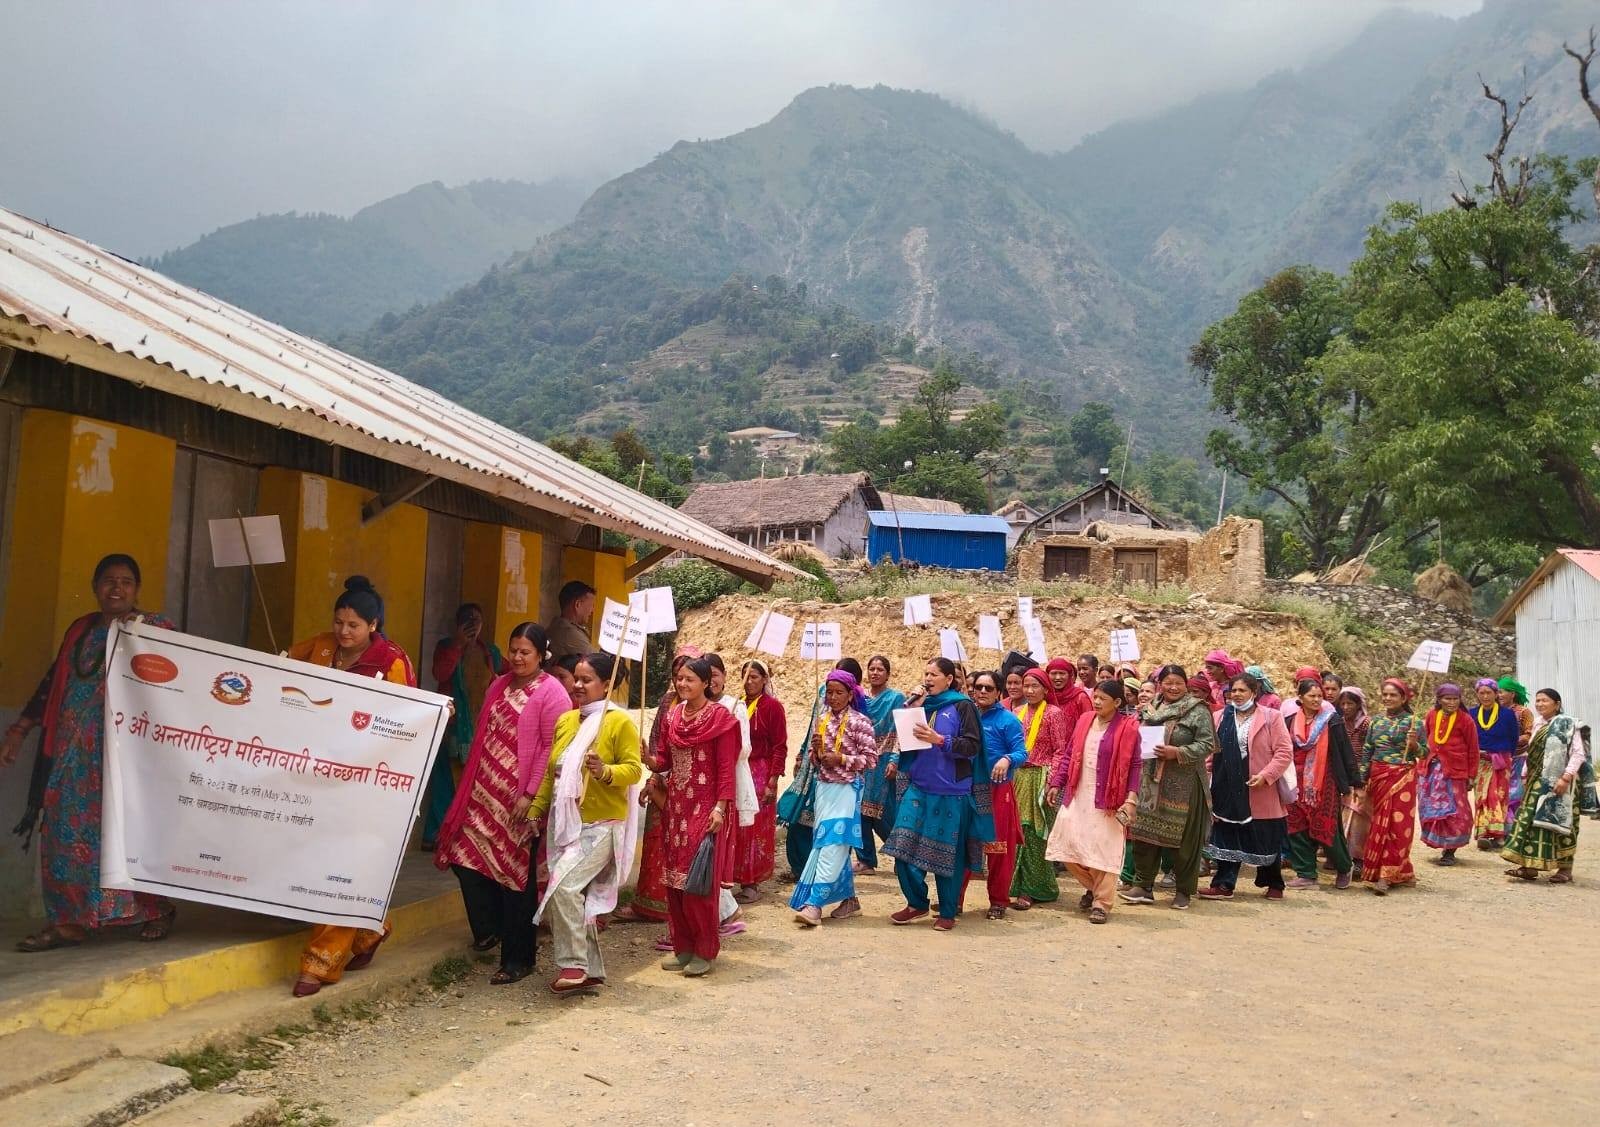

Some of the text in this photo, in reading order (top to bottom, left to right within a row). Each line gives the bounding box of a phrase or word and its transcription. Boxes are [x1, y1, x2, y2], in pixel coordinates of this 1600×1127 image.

[374, 715, 405, 728] Malteser
[371, 723, 418, 738] International
[235, 735, 311, 775] महिनावारी
[313, 758, 372, 784] स्वच्छता
[374, 761, 415, 793] दिवस
